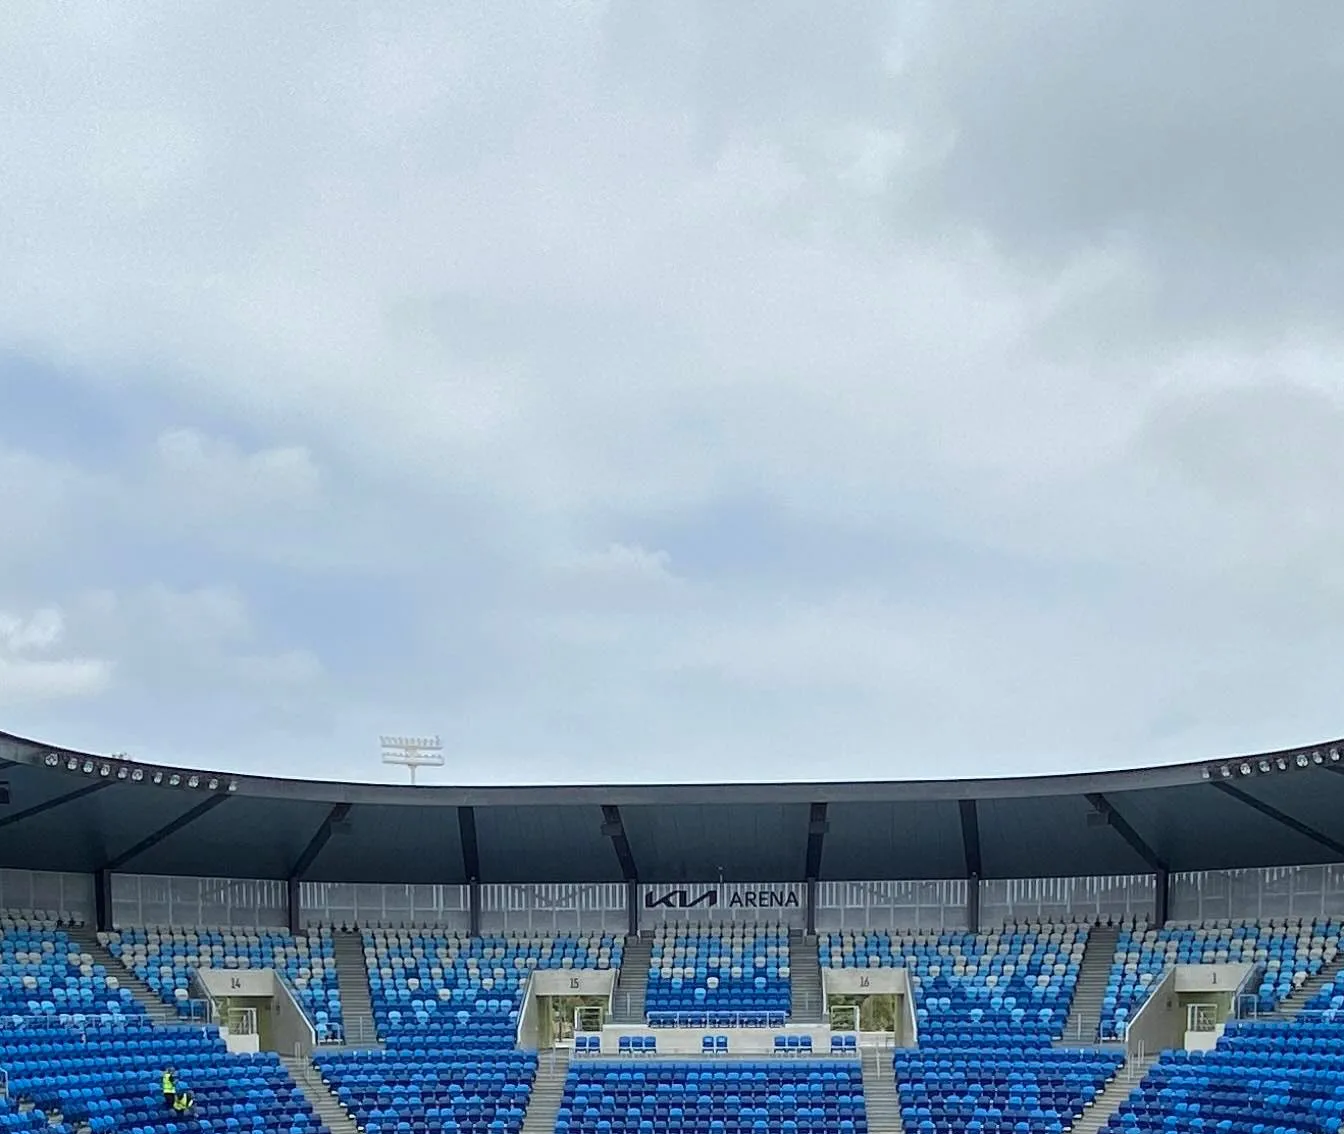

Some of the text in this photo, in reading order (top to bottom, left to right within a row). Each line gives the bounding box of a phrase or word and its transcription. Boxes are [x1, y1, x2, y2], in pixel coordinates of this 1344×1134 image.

[645, 890, 799, 908] KIA ARENA
[231, 977, 240, 989] 14
[570, 977, 579, 988] 15
